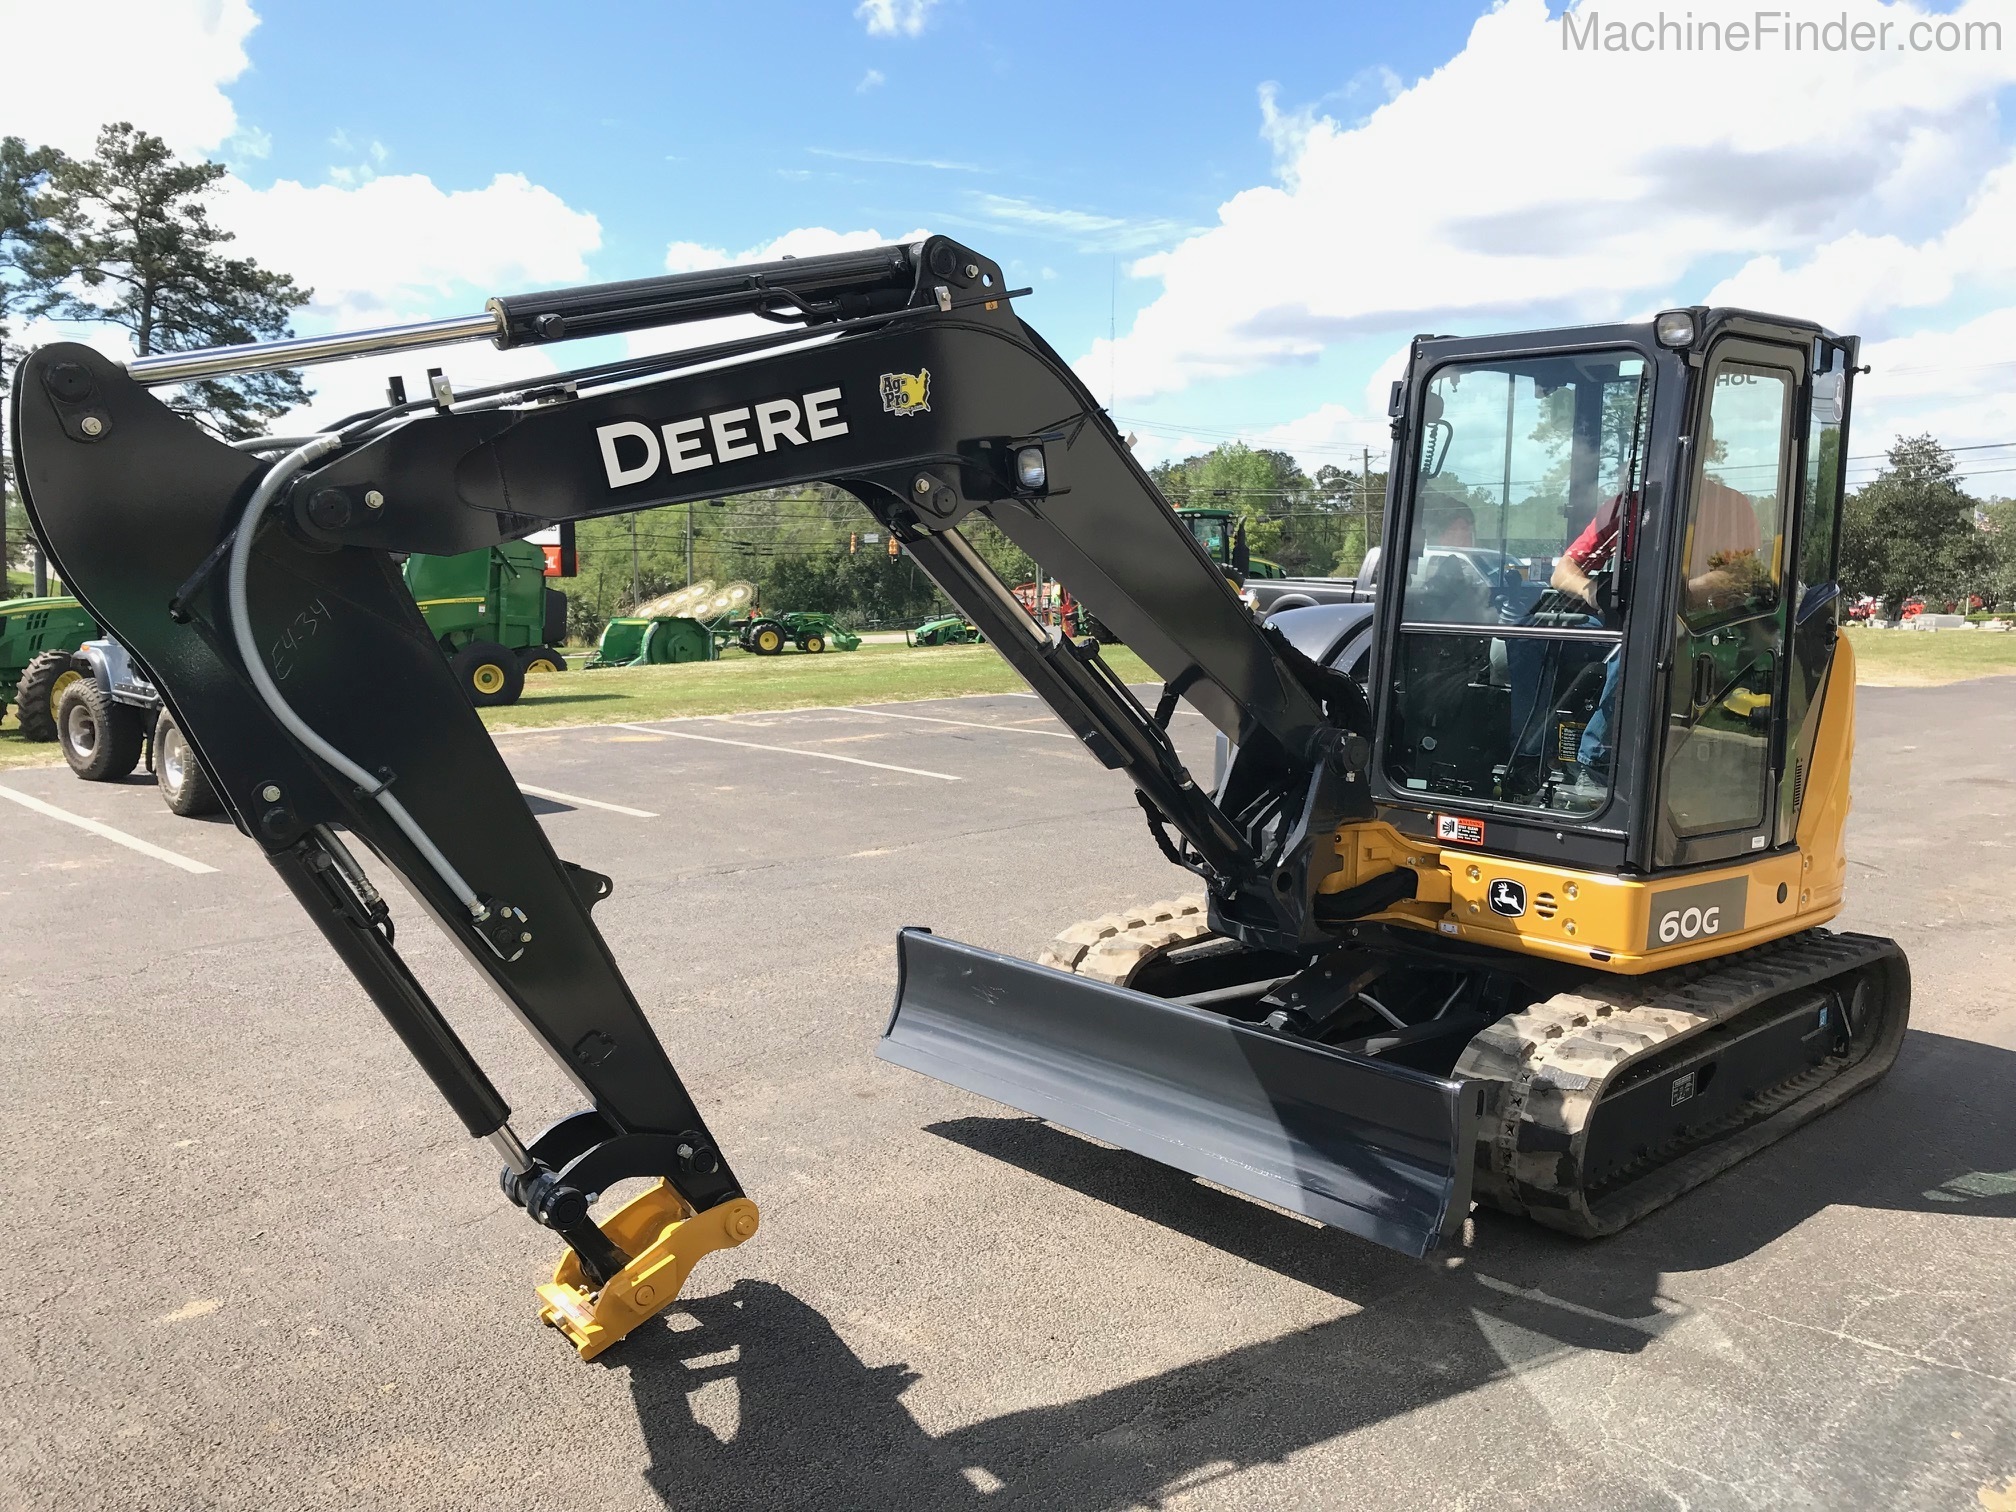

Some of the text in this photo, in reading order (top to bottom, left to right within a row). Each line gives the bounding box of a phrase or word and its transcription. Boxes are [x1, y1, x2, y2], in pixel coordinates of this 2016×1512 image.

[885, 392, 909, 408] Pro
[596, 387, 849, 489] DEERE
[1658, 906, 1720, 943] 60G
